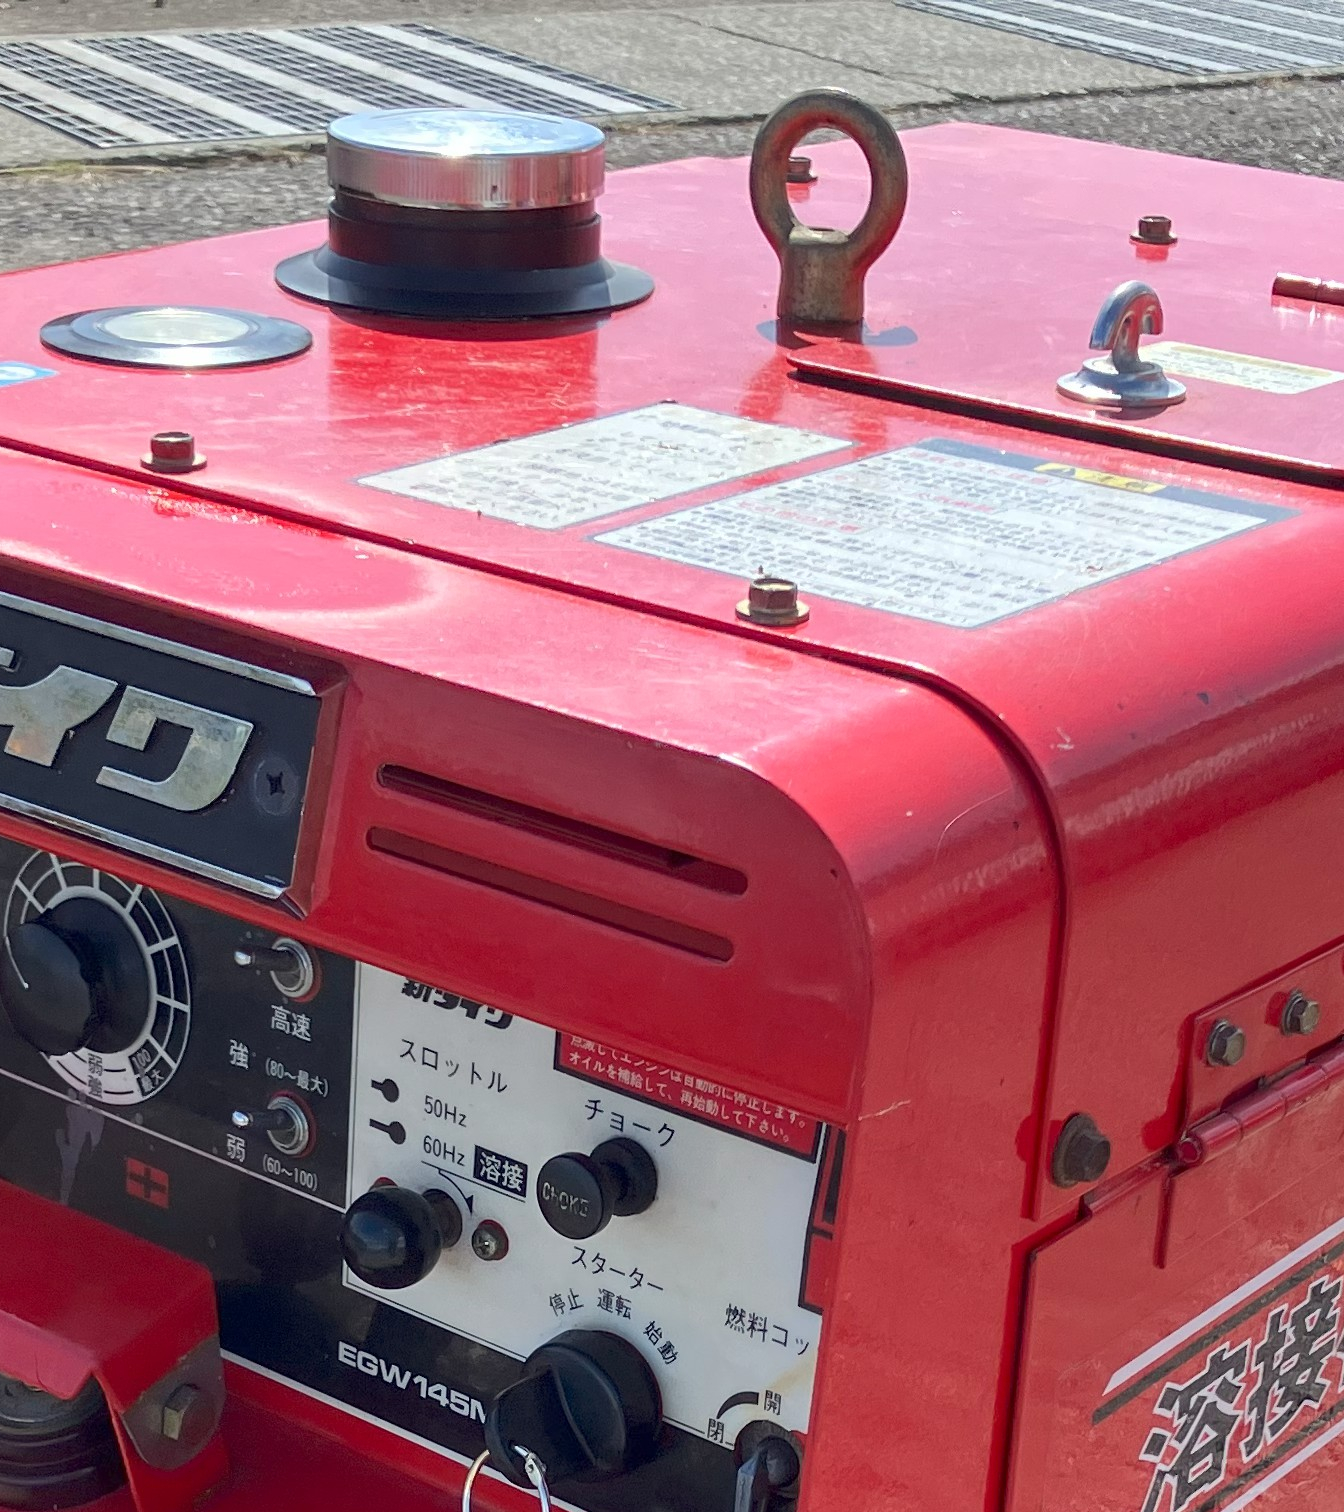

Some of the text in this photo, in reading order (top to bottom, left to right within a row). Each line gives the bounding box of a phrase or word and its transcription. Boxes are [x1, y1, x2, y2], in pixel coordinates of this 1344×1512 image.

[270, 1003, 313, 1042] 高速
[132, 1048, 153, 1069] 100
[229, 1038, 250, 1071] 強
[399, 1038, 508, 1093] スロットル
[423, 1095, 467, 1128] 50Hz
[584, 1098, 676, 1148] チョーク
[226, 1133, 247, 1163] 弱
[422, 1135, 526, 1192] 60Hz 溶接
[541, 1181, 590, 1218] CHOKE
[571, 1245, 664, 1292] スターター
[548, 1287, 680, 1366] 停止 運転 始動
[763, 1389, 783, 1416] 開
[706, 1417, 726, 1444] 閉
